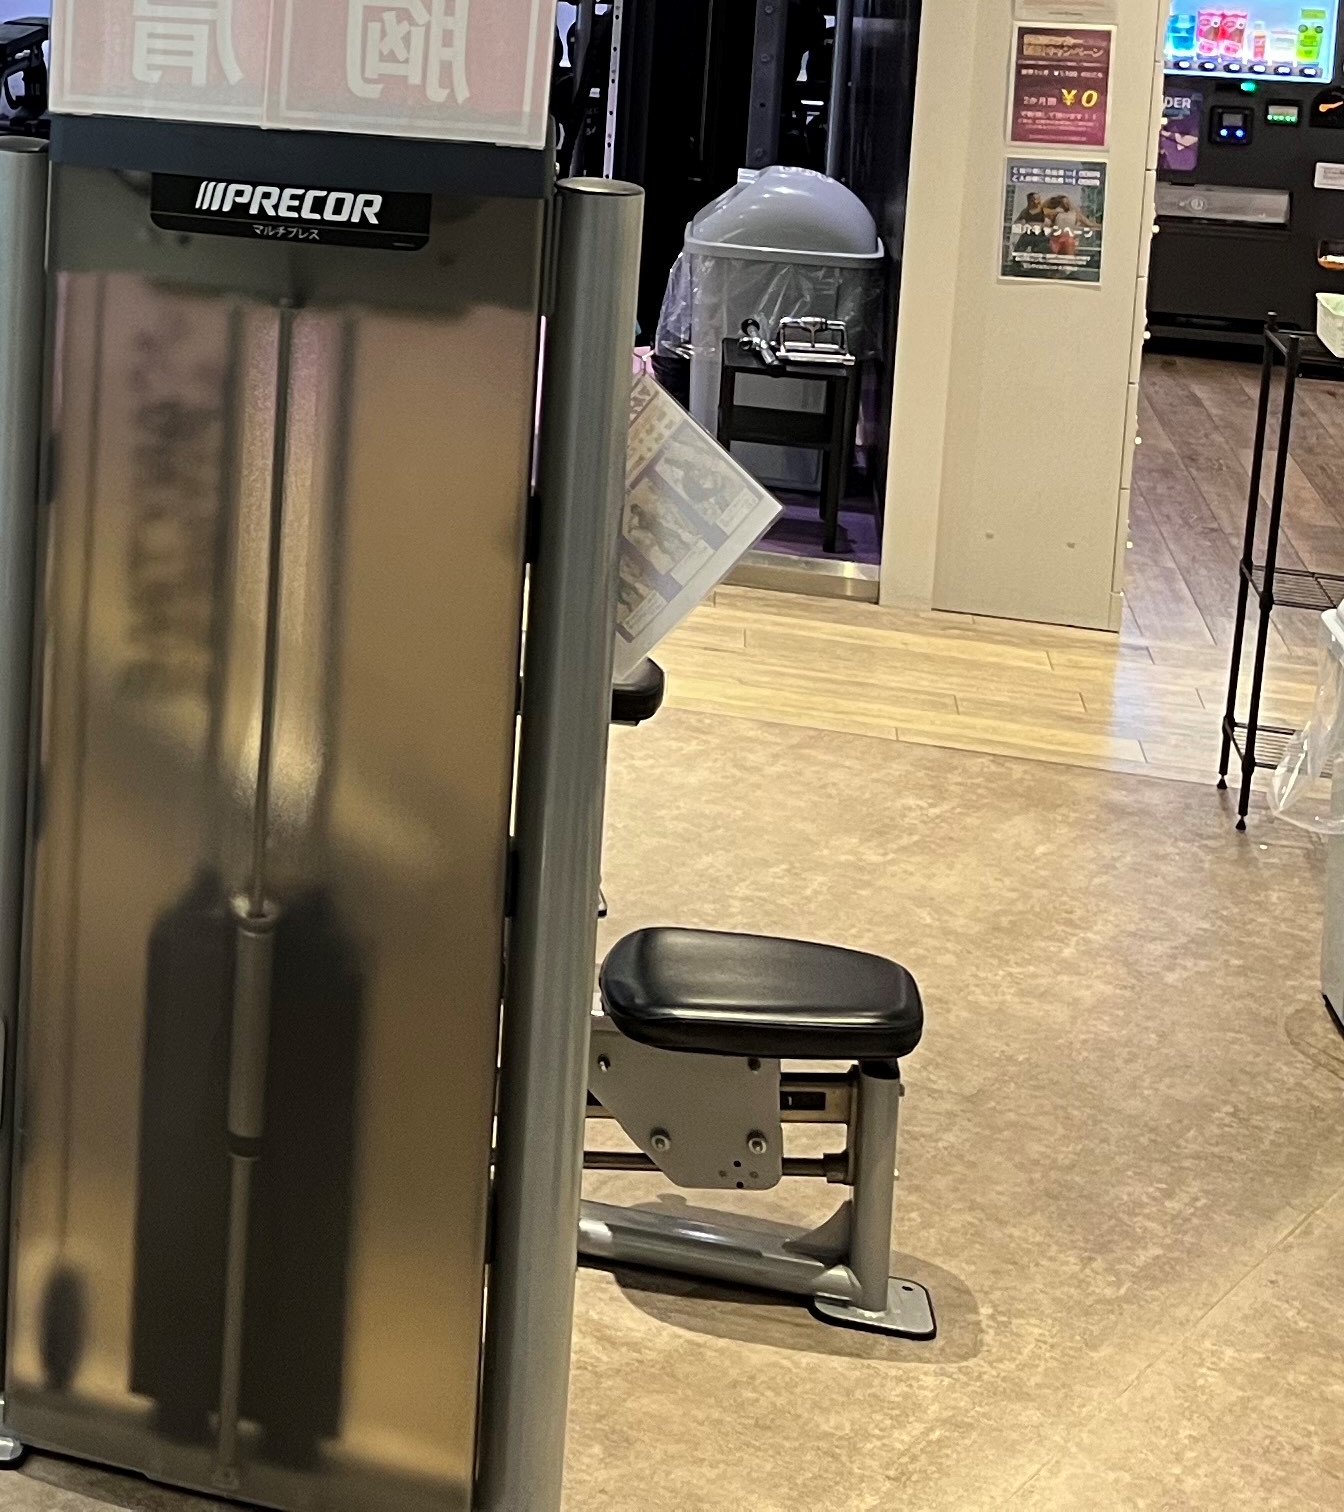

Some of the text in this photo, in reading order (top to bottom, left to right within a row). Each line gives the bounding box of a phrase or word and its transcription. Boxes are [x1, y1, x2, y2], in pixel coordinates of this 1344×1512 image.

[222, 183, 383, 225] PRECOR
[253, 225, 320, 240] マルチプレス
